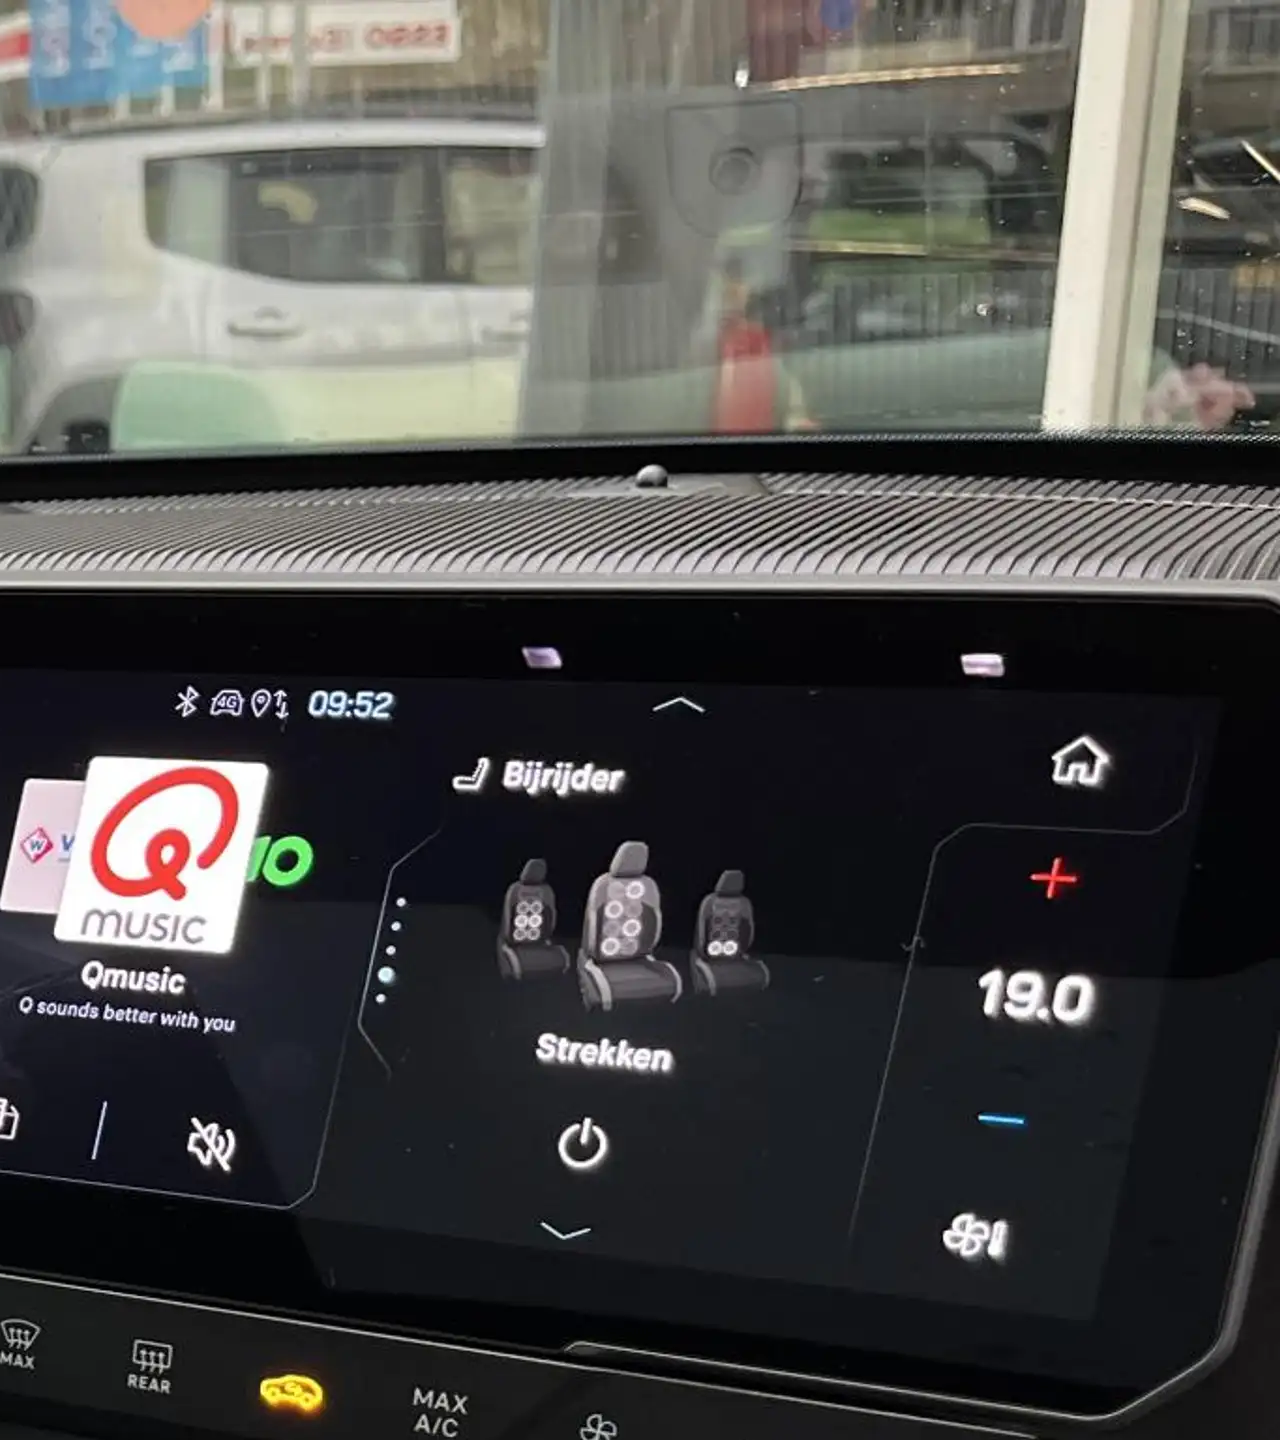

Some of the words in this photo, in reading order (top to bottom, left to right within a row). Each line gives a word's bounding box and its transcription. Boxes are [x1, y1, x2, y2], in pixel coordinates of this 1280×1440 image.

[307, 689, 394, 720] 09:52
[502, 759, 626, 797] Bijrijder
[89, 766, 239, 901] Q
[80, 959, 187, 995] Qmusic
[978, 967, 1096, 1025] 19.0
[19, 996, 34, 1015] Q
[37, 1001, 100, 1020] sounds
[103, 1003, 158, 1025] better
[160, 1010, 200, 1030] with
[203, 1017, 237, 1034] you
[535, 1032, 675, 1074] Strekken
[126, 1373, 172, 1395] REAR
[412, 1386, 469, 1416] MAX
[413, 1413, 460, 1438] A/C
